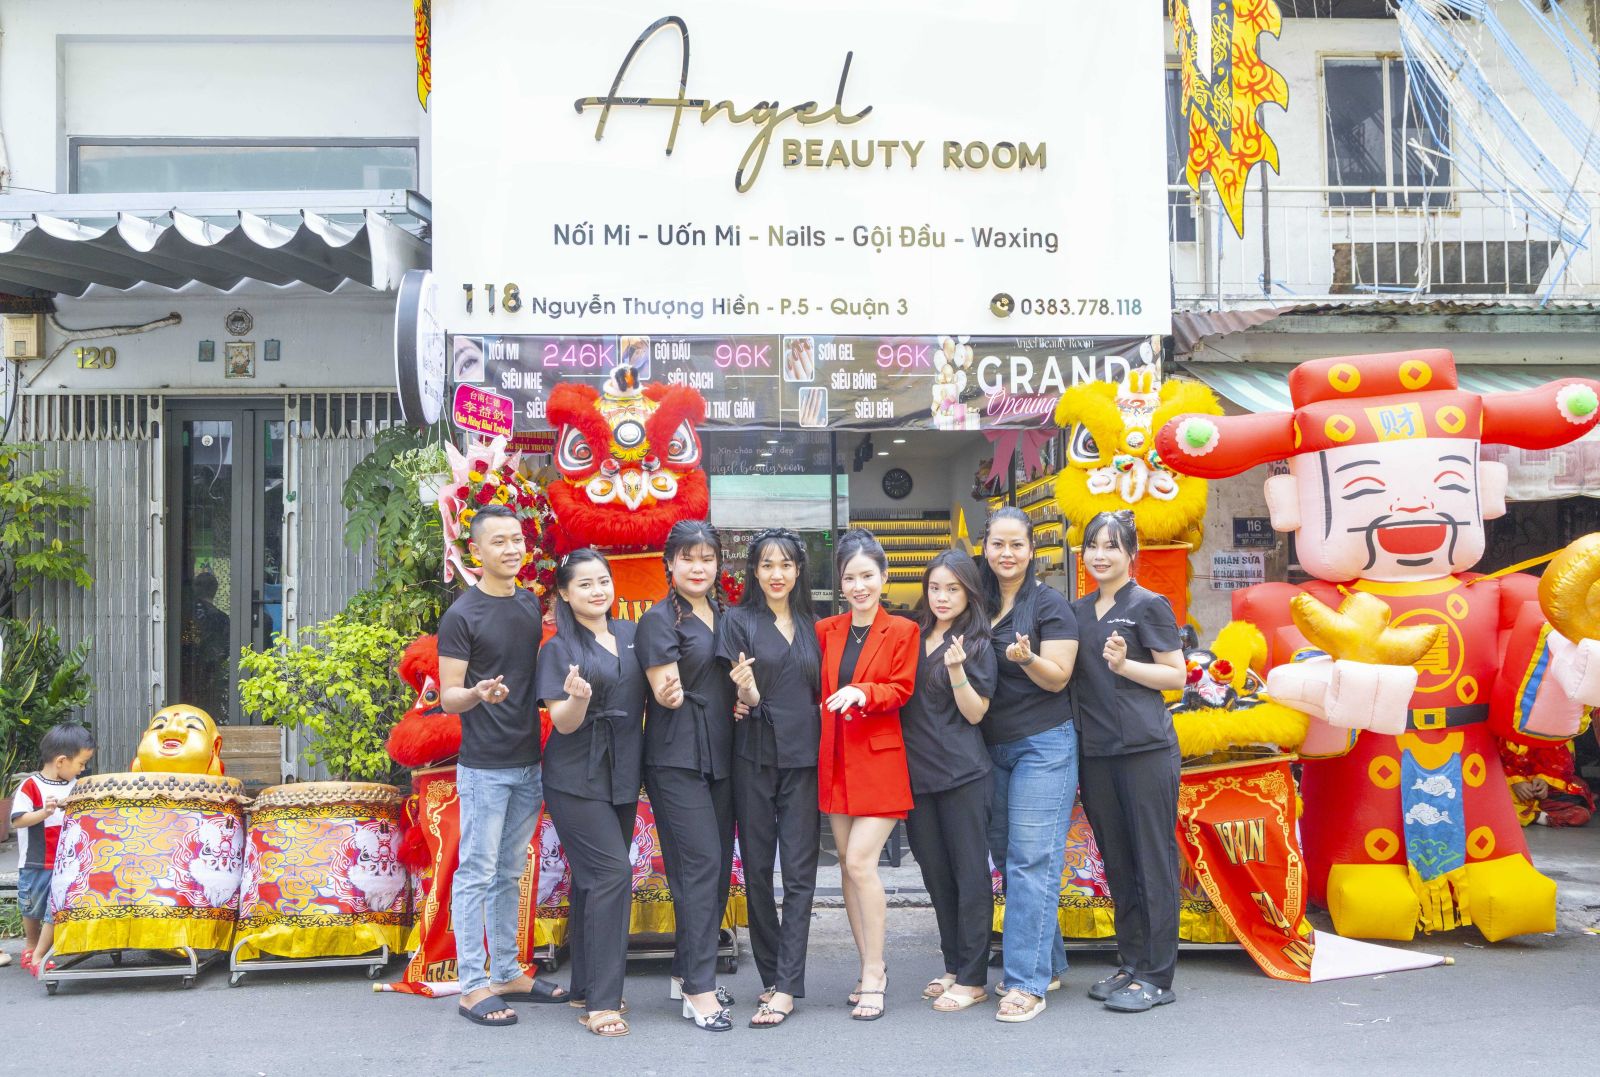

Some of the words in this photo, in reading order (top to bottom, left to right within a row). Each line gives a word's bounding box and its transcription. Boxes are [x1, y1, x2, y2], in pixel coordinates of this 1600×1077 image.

[574, 15, 873, 193] Angel
[782, 138, 925, 169] BEAUTY
[942, 140, 1048, 170] ROOM
[553, 221, 594, 247] Nối
[604, 225, 630, 247] Mi
[657, 222, 706, 247] Uốn
[715, 225, 741, 247] Mi
[767, 225, 826, 248] Nails
[852, 224, 893, 254] Gội
[898, 223, 946, 249] Đầu
[971, 227, 1059, 254] Waxing
[462, 283, 522, 314] 118
[532, 293, 616, 319] Nguyễn
[622, 296, 704, 320] Thượng
[711, 293, 760, 315] Hiền
[780, 298, 809, 315] P.5
[830, 296, 889, 320] Quận
[896, 298, 909, 315] 3
[1020, 298, 1143, 316] 0383.778.118
[72, 346, 117, 369] 120
[489, 339, 504, 360] NỐI
[506, 343, 520, 360] MI
[543, 343, 615, 368] 246K
[654, 339, 671, 364] GỘI
[714, 343, 771, 368] 96K
[818, 342, 837, 361] SƠN
[838, 343, 855, 361] GEL
[876, 344, 931, 368] 96K
[501, 367, 522, 390] SIÊU
[523, 371, 543, 393] NHẸ
[831, 367, 851, 390] SIÊU
[852, 368, 877, 390] BÓNG
[976, 355, 1131, 396] GRAND
[712, 399, 733, 418] THƯ
[854, 396, 875, 419] SIÊU
[985, 386, 1058, 426] Opening
[1246, 519, 1262, 532] 116
[1213, 555, 1240, 567] NHẬN
